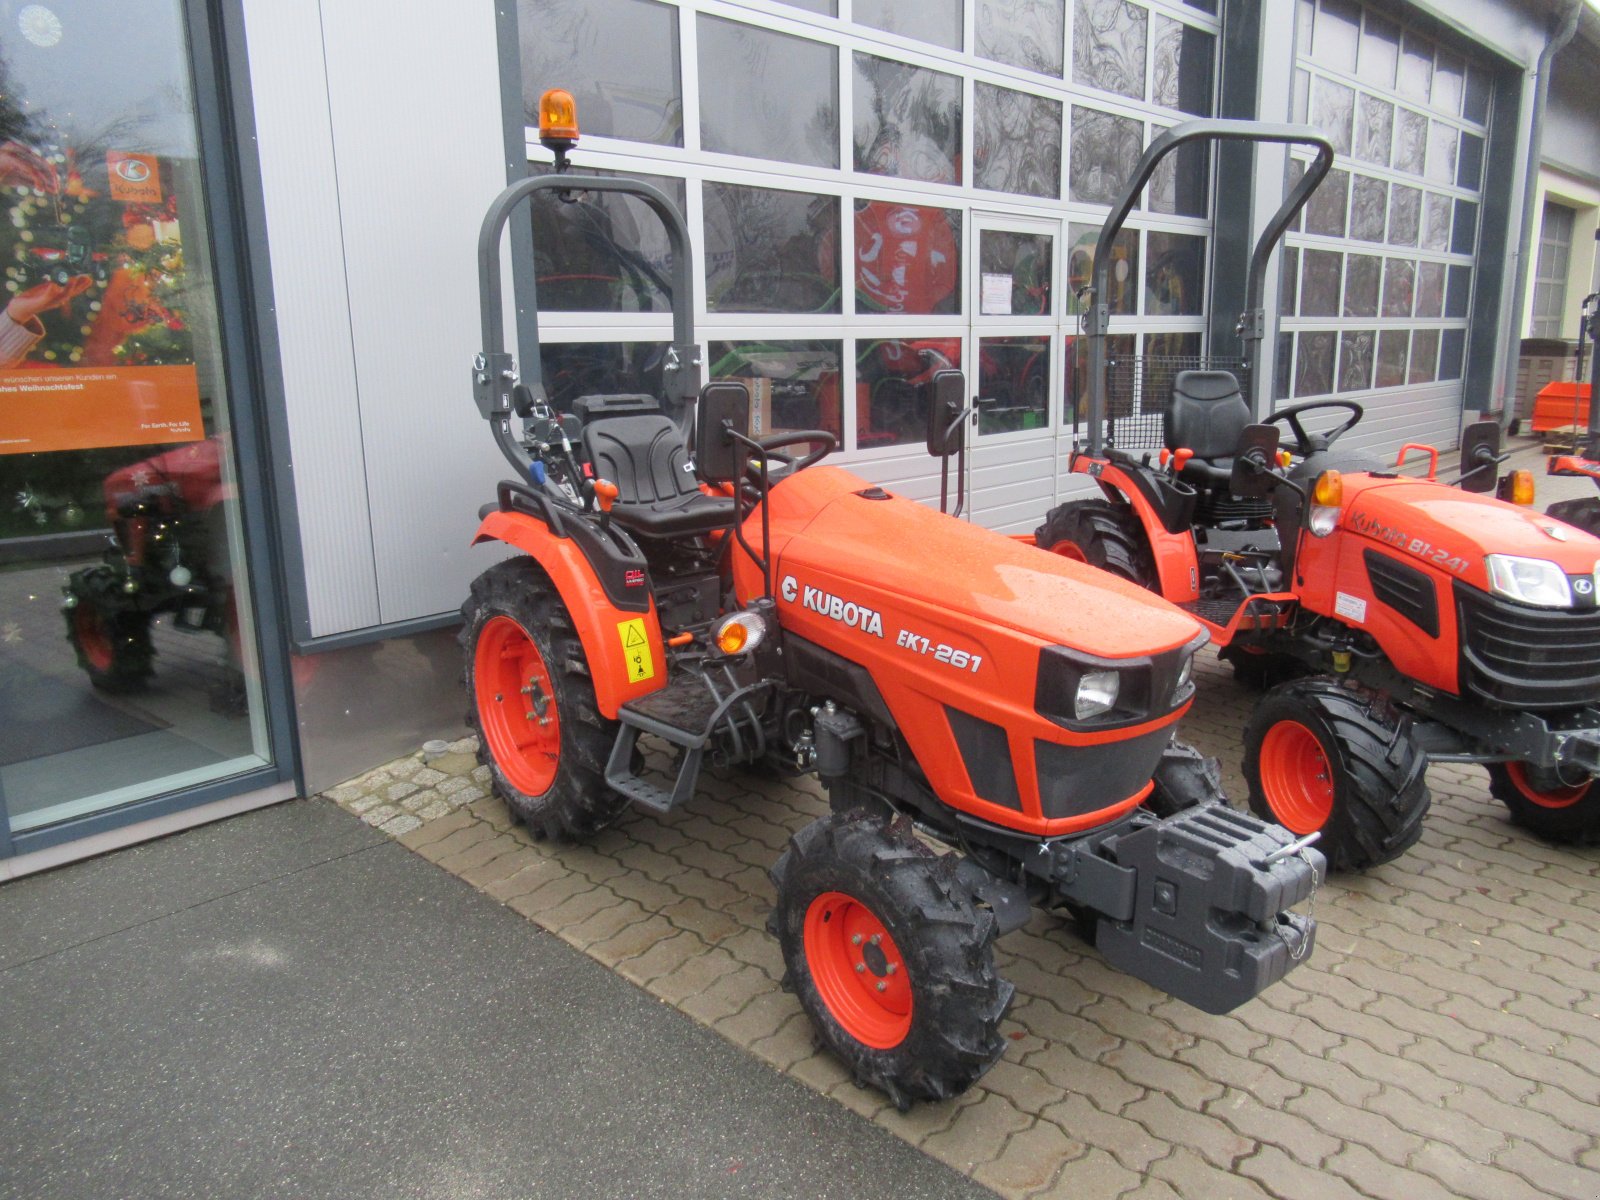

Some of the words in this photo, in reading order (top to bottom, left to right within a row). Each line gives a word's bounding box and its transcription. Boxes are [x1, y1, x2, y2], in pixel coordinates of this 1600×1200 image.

[19, 384, 84, 392] Weihnachtsfest
[1351, 511, 1406, 546] Kubota
[1408, 539, 1470, 573] B1-241
[803, 584, 884, 638] KUBOTA
[896, 629, 983, 673] EK1-261
